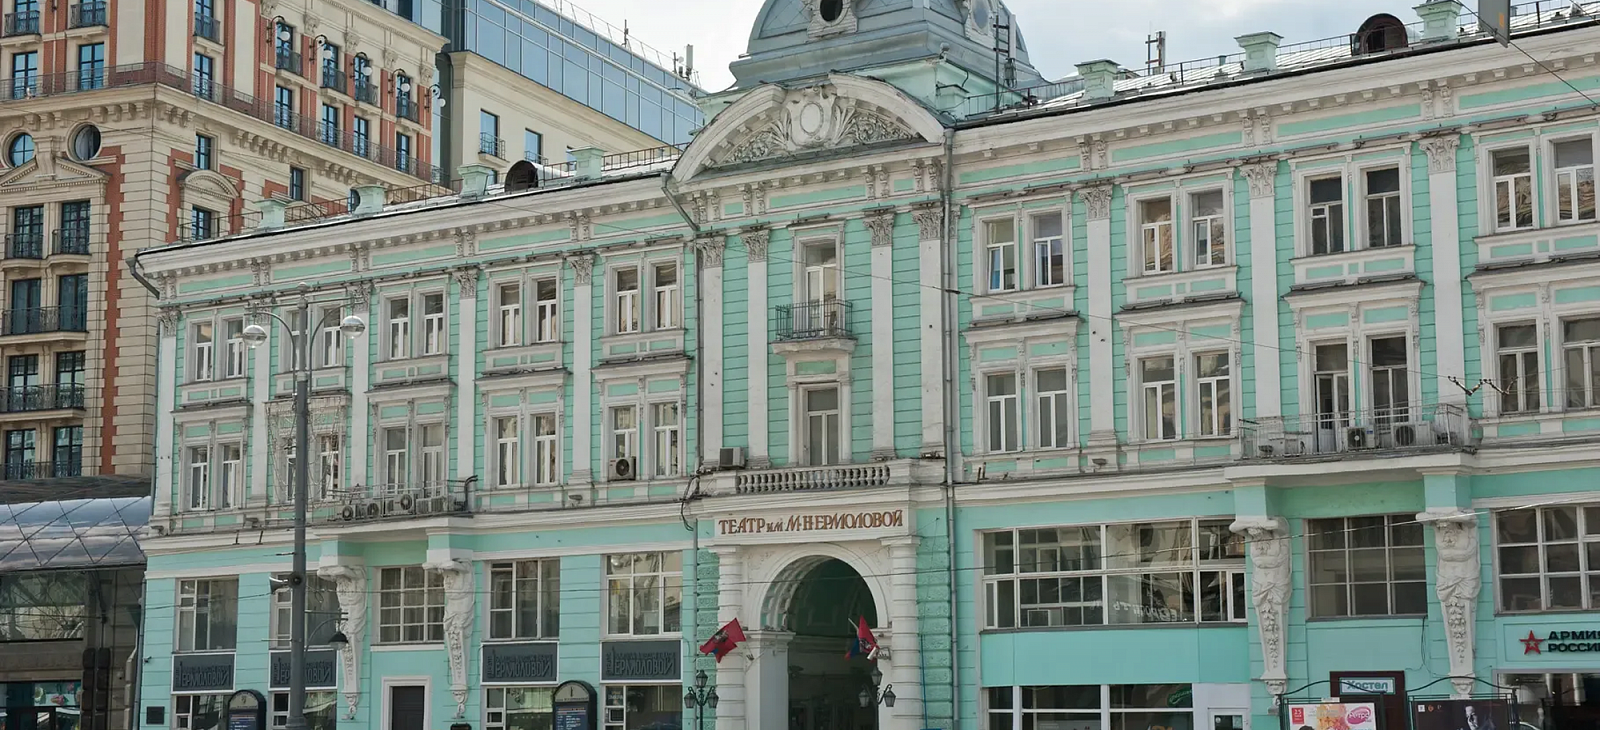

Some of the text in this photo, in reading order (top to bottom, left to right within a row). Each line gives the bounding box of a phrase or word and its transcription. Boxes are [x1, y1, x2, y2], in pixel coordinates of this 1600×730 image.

[718, 517, 766, 535] ТЕАТР
[1548, 630, 1600, 640] АРМИ
[1548, 642, 1600, 652] РОССИ
[1346, 680, 1389, 691] Хостел
